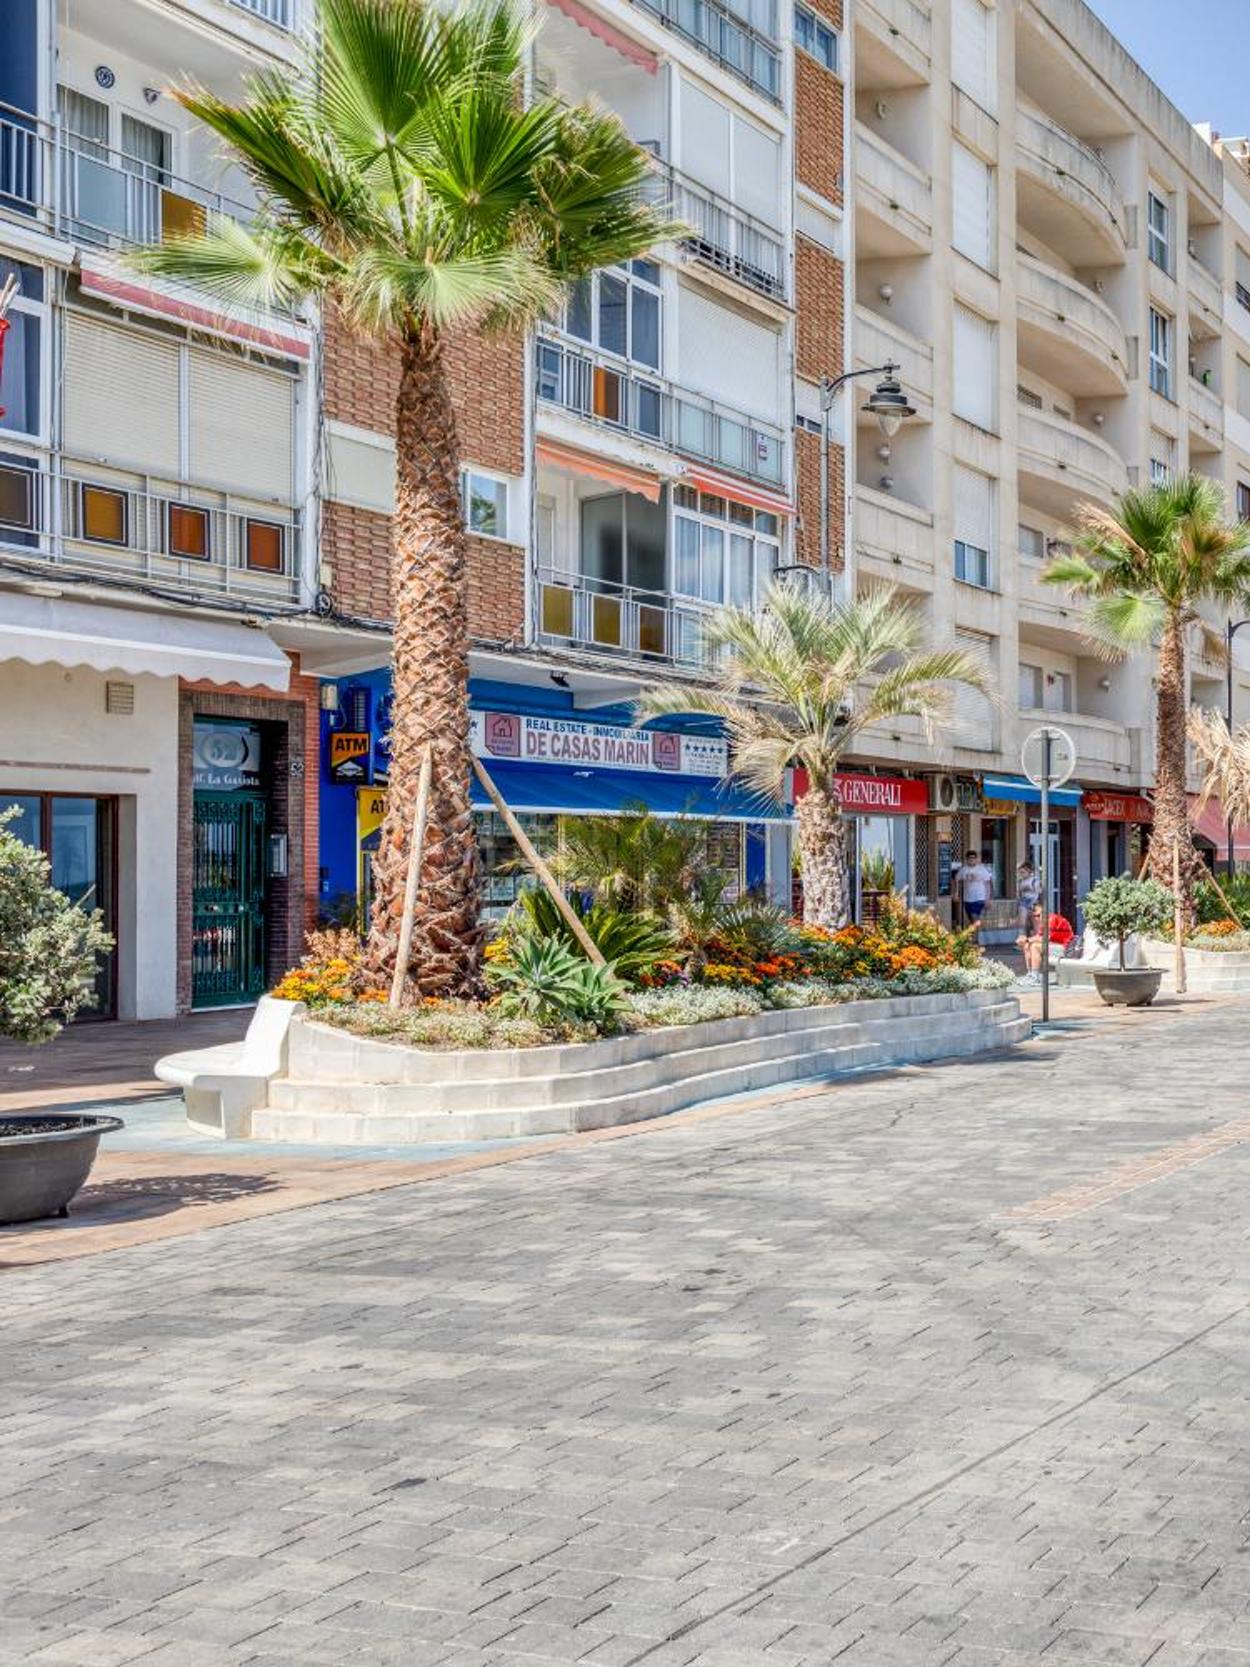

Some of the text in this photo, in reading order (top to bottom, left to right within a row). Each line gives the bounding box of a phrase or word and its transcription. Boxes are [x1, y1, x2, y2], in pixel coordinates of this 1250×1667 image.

[527, 718, 551, 731] REAL
[554, 722, 587, 735] ESTATE
[335, 738, 367, 751] ATM
[527, 731, 547, 756] DE
[551, 733, 601, 760] CASAS
[604, 738, 649, 764] MARIN
[290, 762, 304, 777] 52
[208, 773, 221, 784] La
[844, 780, 902, 806] GENERALI
[371, 799, 390, 814] AT
